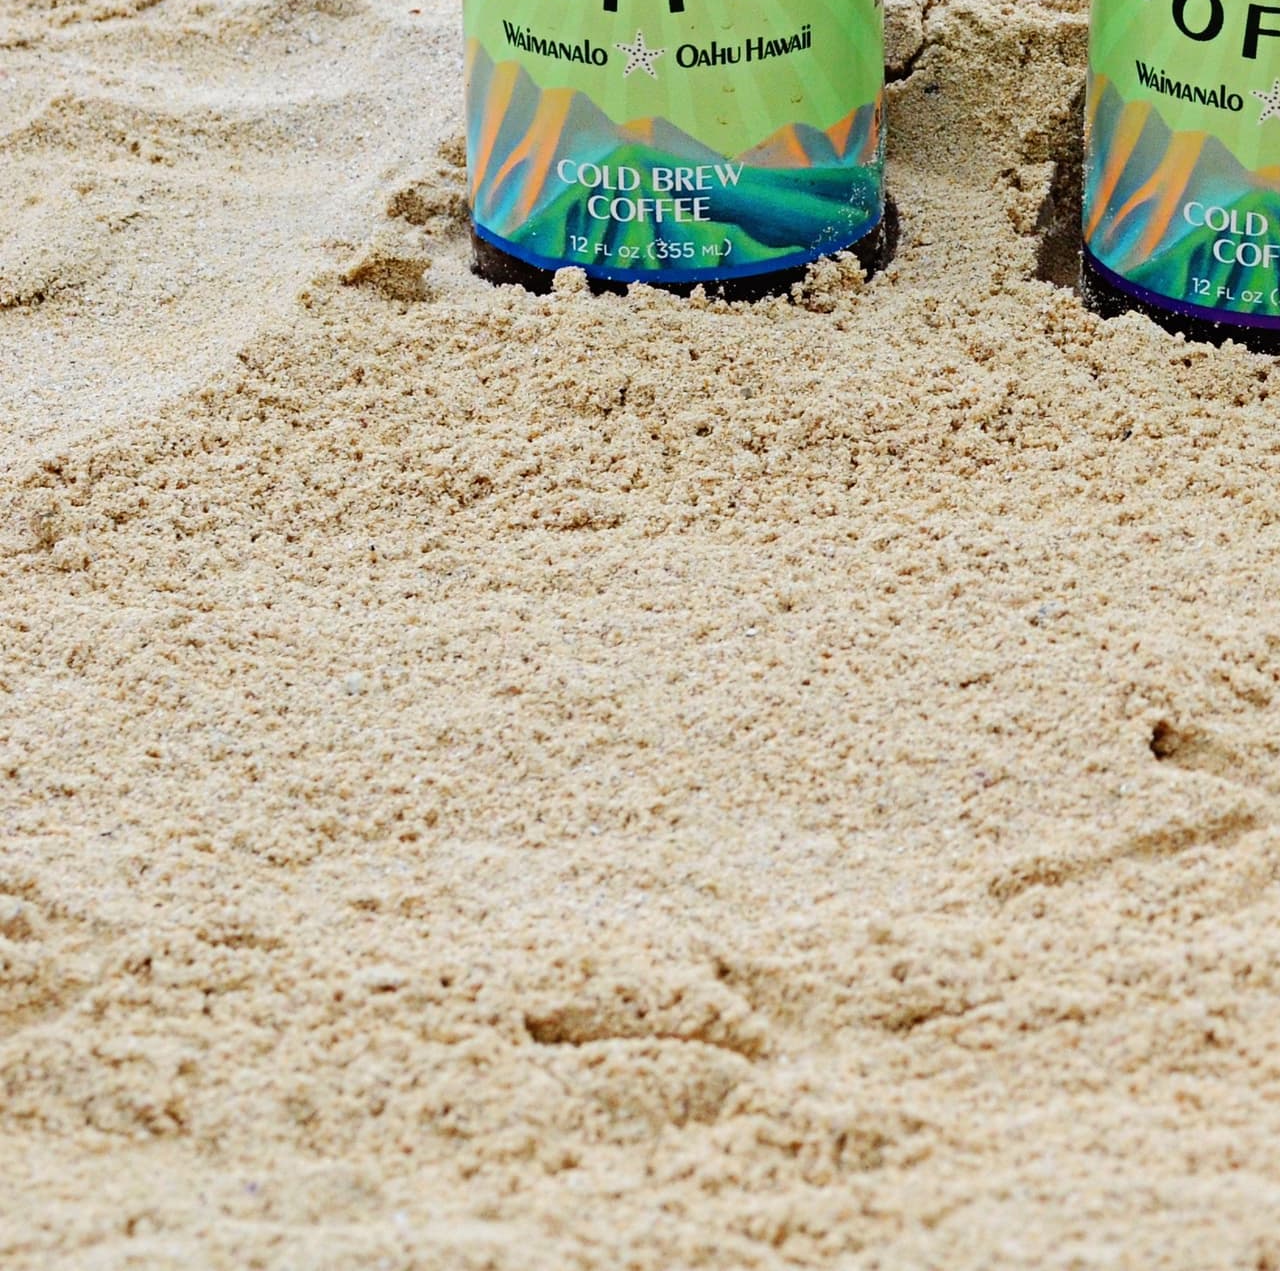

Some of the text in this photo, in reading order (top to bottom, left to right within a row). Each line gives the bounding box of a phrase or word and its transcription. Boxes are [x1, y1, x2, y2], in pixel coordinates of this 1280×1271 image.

[557, 159, 744, 192] COLD BREW
[588, 195, 711, 223] COFFEE
[1183, 202, 1269, 236] COLD
[569, 235, 732, 260] 12 FL OZ (355 ML)
[1192, 278, 1211, 295] 12
[1216, 288, 1234, 301] FL
[1241, 290, 1263, 303] OZ
